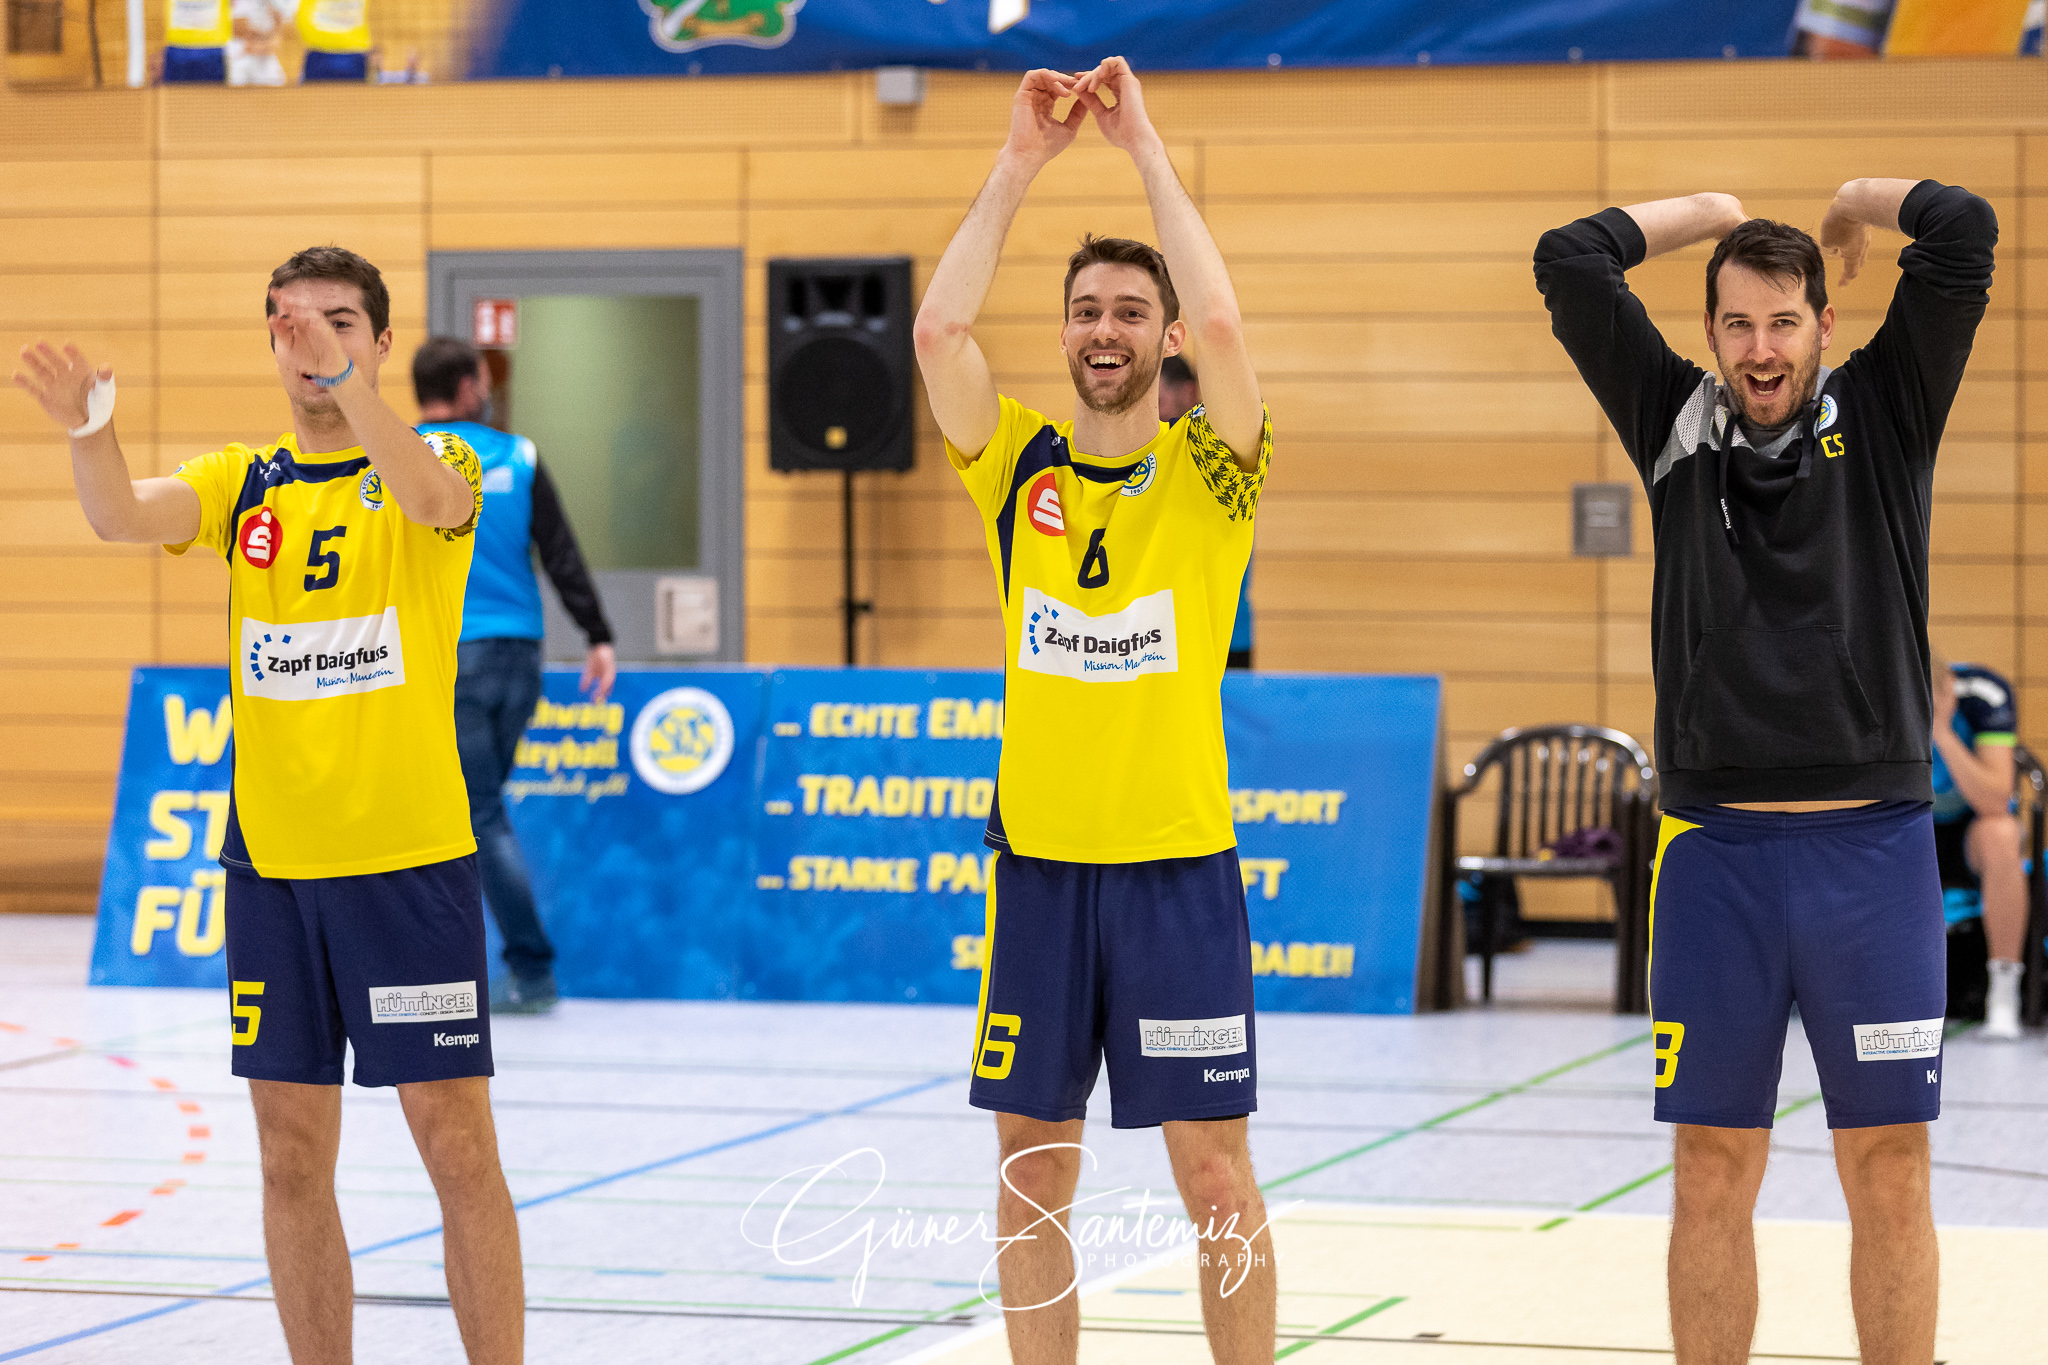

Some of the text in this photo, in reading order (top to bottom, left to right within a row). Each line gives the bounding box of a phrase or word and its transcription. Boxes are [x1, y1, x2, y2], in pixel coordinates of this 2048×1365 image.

[1821, 433, 1845, 458] CS
[1720, 498, 1732, 529] Kempa
[303, 525, 347, 592] 5
[1077, 528, 1110, 589] 6
[1045, 626, 1162, 657] Zapf Daigfuss
[267, 645, 389, 677] Zapf Daigfuss
[809, 702, 920, 739] ECHTE
[797, 774, 997, 819] TRADITIO
[1229, 789, 1347, 824] SPORT
[788, 855, 920, 893] STARKE
[232, 980, 265, 1046] 5
[433, 1032, 480, 1049] Kempa
[975, 1012, 1022, 1080] 6
[1203, 1067, 1250, 1083] Kempa
